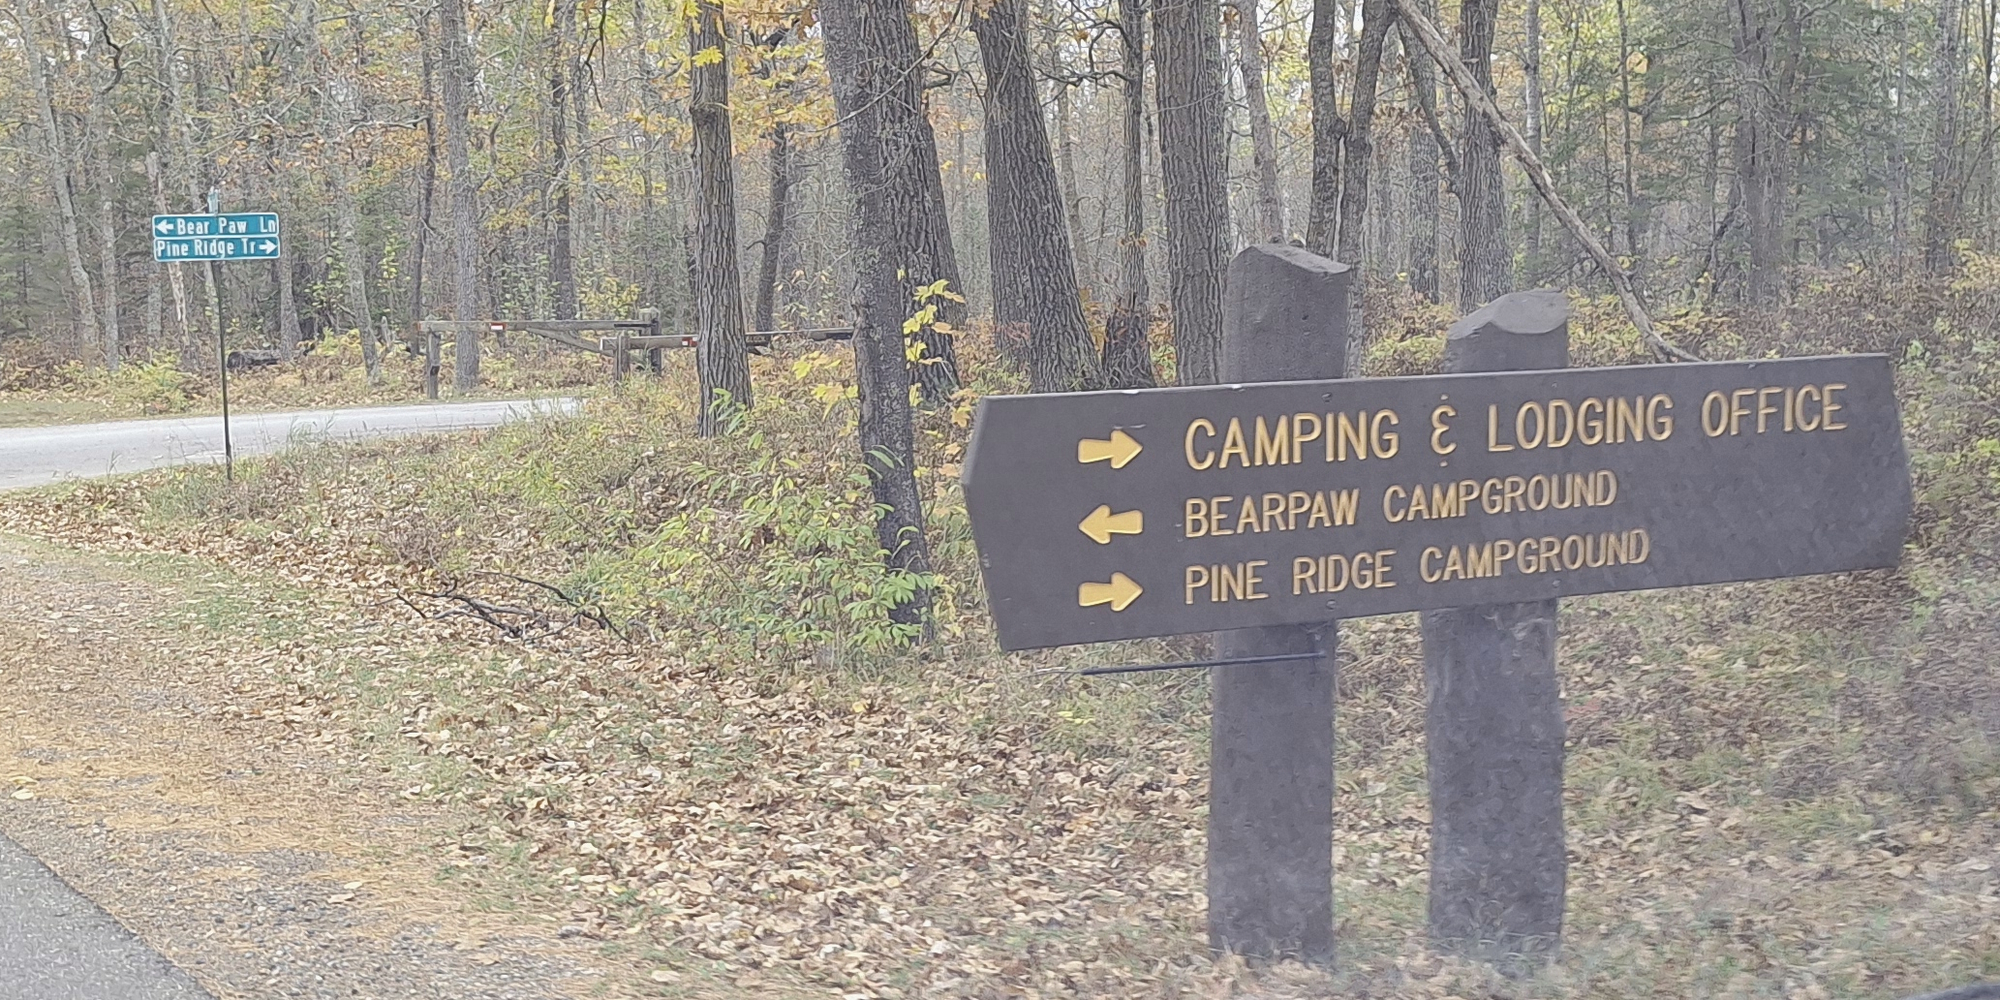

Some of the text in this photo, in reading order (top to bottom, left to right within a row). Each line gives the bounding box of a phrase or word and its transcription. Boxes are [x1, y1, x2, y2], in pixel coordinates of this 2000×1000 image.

[157, 238, 256, 258] Pine Ridge Tr
[177, 216, 276, 235] Bear Paw Ln
[1184, 383, 1848, 470] CAMPING & LODGING OFFICE
[1184, 469, 1618, 538] BEARPAW CAMPGROUND
[1184, 527, 1651, 605] PINE RIDGE CAMPGROUND
